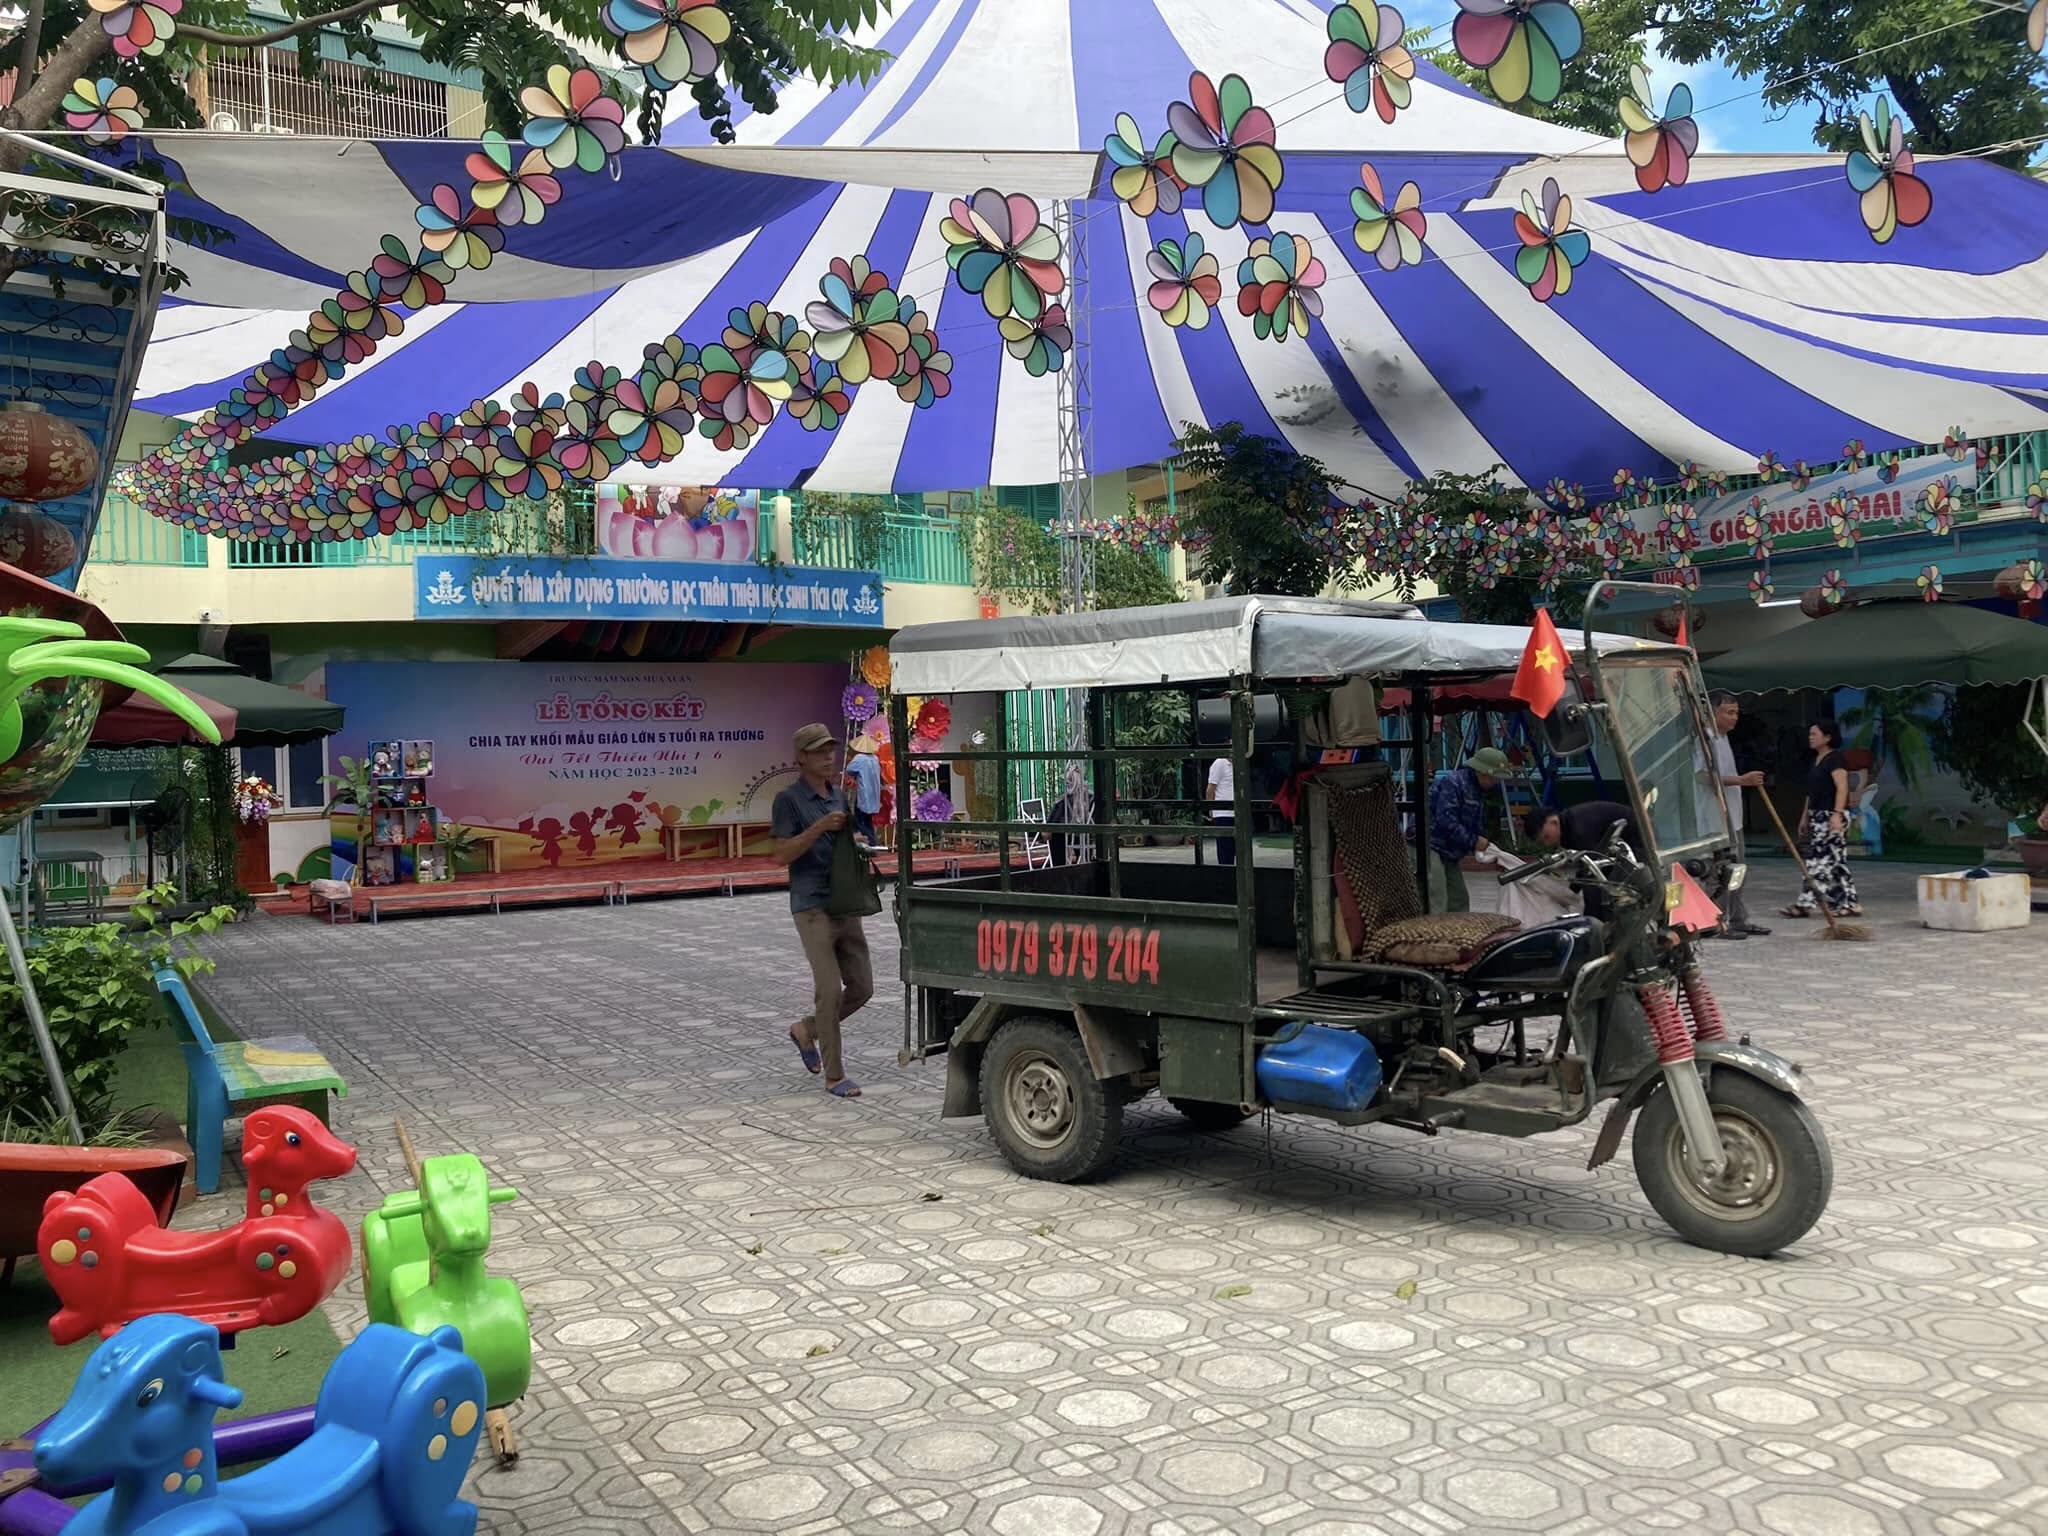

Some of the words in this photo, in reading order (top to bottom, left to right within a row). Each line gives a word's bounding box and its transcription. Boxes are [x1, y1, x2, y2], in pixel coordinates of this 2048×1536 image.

[1858, 490, 1901, 521] MAI
[472, 566, 514, 605] QUYẾT
[546, 570, 572, 604] XÂY
[574, 578, 614, 612] DỤNG
[616, 573, 669, 606] TRƯỜNG
[672, 581, 697, 614] HỌC
[699, 576, 729, 607] THÂN
[730, 577, 760, 615] THIỆN
[786, 584, 809, 610] SINH
[811, 580, 830, 611] TÍCH
[832, 587, 850, 618] CỰC
[537, 694, 571, 720] LỄ
[576, 692, 649, 720] TỔNG
[653, 692, 704, 719] KẾT
[469, 735, 502, 747] CHIA
[505, 735, 527, 746] TAY
[530, 730, 562, 746] KHỐI
[598, 730, 628, 744] GIÁO
[631, 731, 656, 744] LỚN
[659, 732, 666, 743] 5
[669, 728, 697, 743] TUỔI
[699, 731, 715, 742] RA
[718, 728, 765, 742] TRƯỜNG
[549, 768, 584, 779] NĂM
[589, 767, 622, 780] HỌC
[626, 767, 657, 777] 2023
[668, 765, 698, 776] 2024
[977, 919, 1041, 976] 0979
[1049, 921, 1098, 981] 379
[1107, 925, 1161, 985] 204
